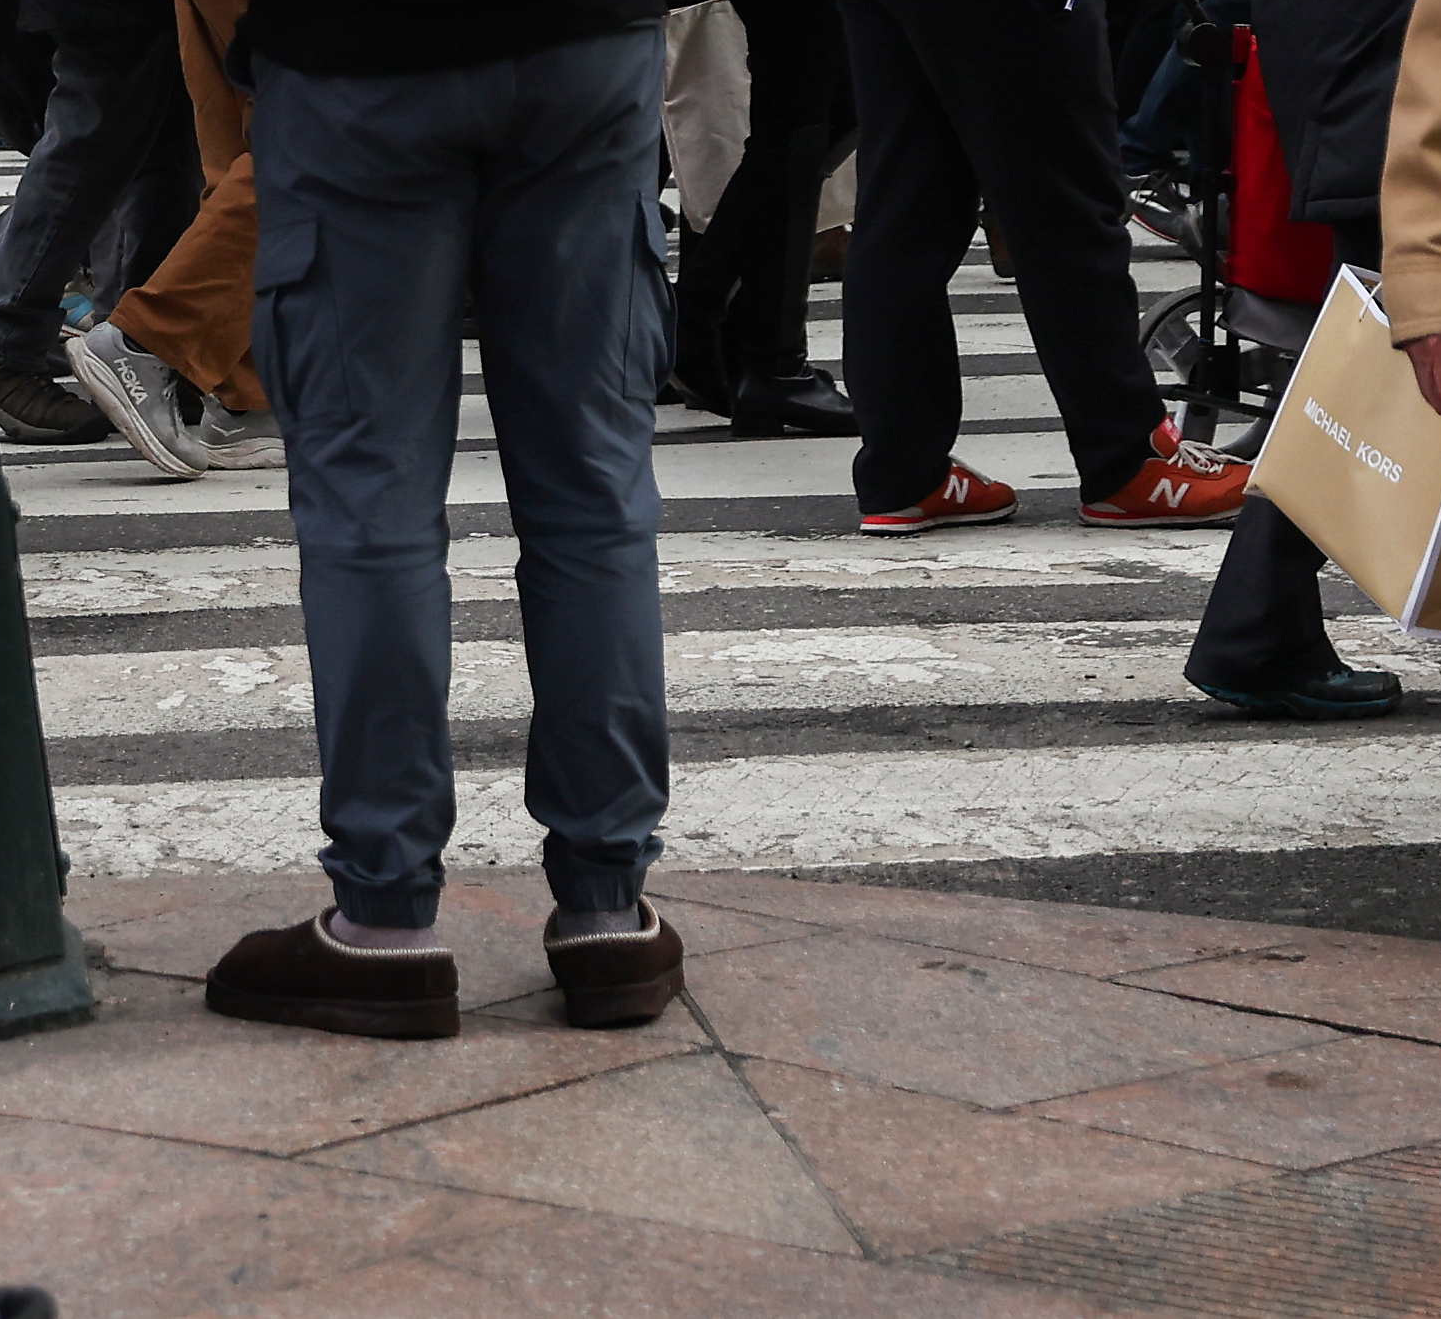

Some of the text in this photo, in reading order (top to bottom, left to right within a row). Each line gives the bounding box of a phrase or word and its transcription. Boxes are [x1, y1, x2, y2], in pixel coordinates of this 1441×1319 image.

[113, 356, 148, 406] HOKA
[1302, 396, 1404, 484] MICHAEL KORS
[942, 474, 970, 505] N
[1148, 476, 1191, 508] N
